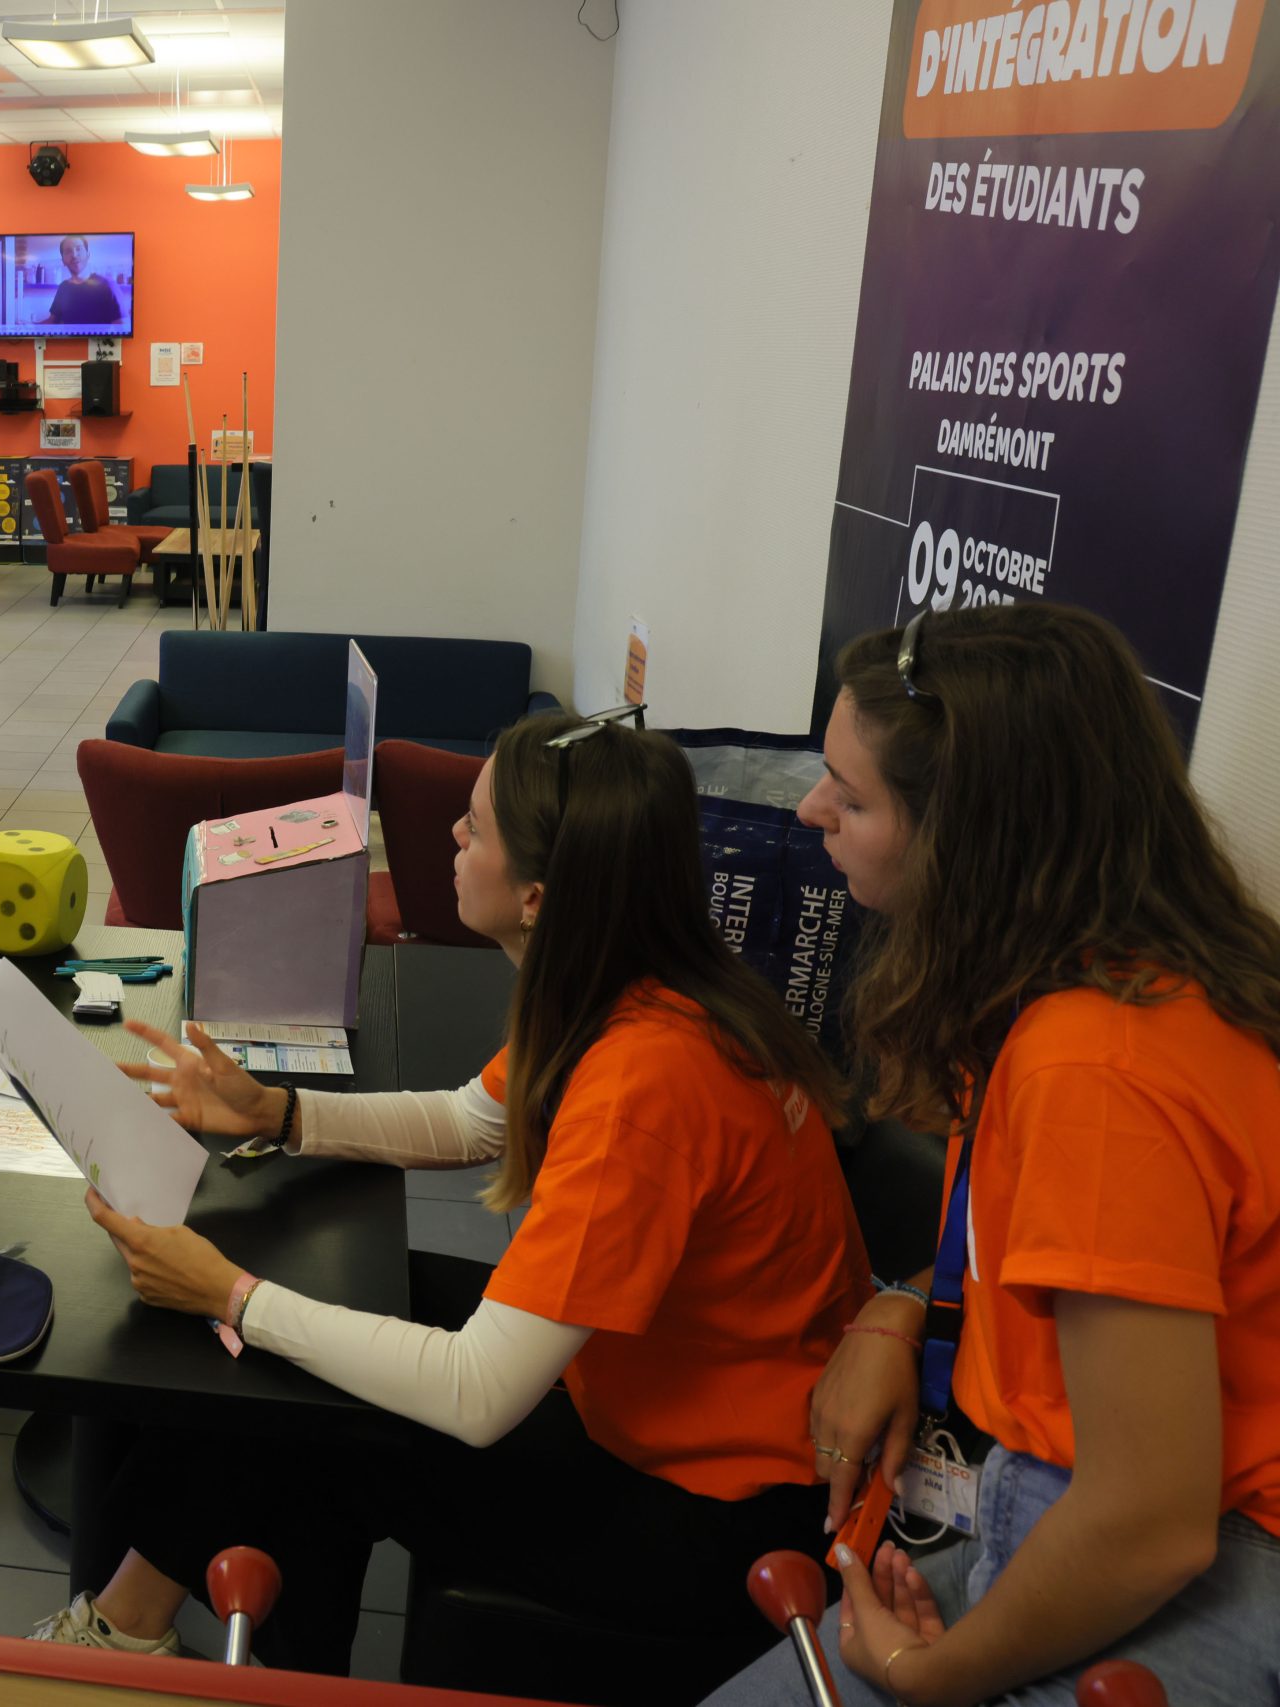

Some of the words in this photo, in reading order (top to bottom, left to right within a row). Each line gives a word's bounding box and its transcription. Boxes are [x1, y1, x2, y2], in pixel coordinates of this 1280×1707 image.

[924, 161, 970, 215] DES
[970, 147, 1146, 235] ÉTUDIANTS
[908, 350, 975, 393] PALAIS
[974, 351, 1018, 397] DES
[1018, 351, 1127, 405] SPORTS
[936, 411, 1056, 472] DAMRÉMONT
[907, 520, 961, 614] 09
[962, 536, 1048, 596] OCTOBRE
[784, 884, 829, 1019] ERMARCHÉ
